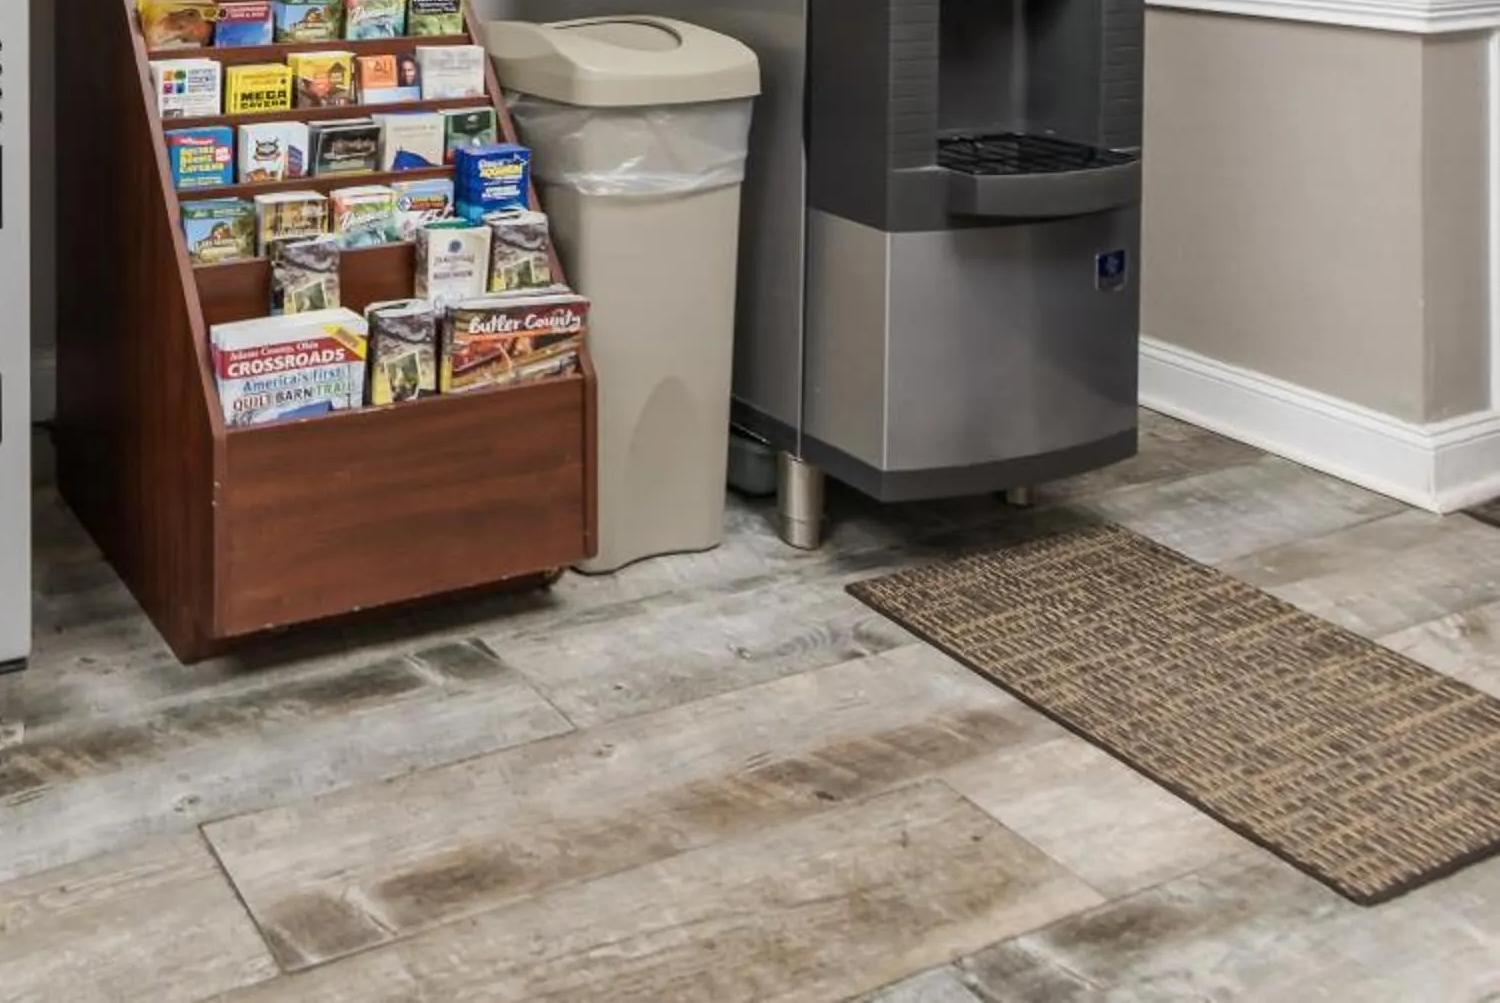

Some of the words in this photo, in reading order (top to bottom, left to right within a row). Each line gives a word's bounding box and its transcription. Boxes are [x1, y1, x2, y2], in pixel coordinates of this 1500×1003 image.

[240, 90, 287, 102] MEGA
[240, 101, 287, 110] CAVERN
[469, 314, 519, 334] Butler
[524, 310, 581, 331] County
[227, 348, 346, 377] CROSSROADS
[243, 372, 310, 392] America's
[233, 392, 273, 412] QUILT
[275, 387, 313, 404] BARN
